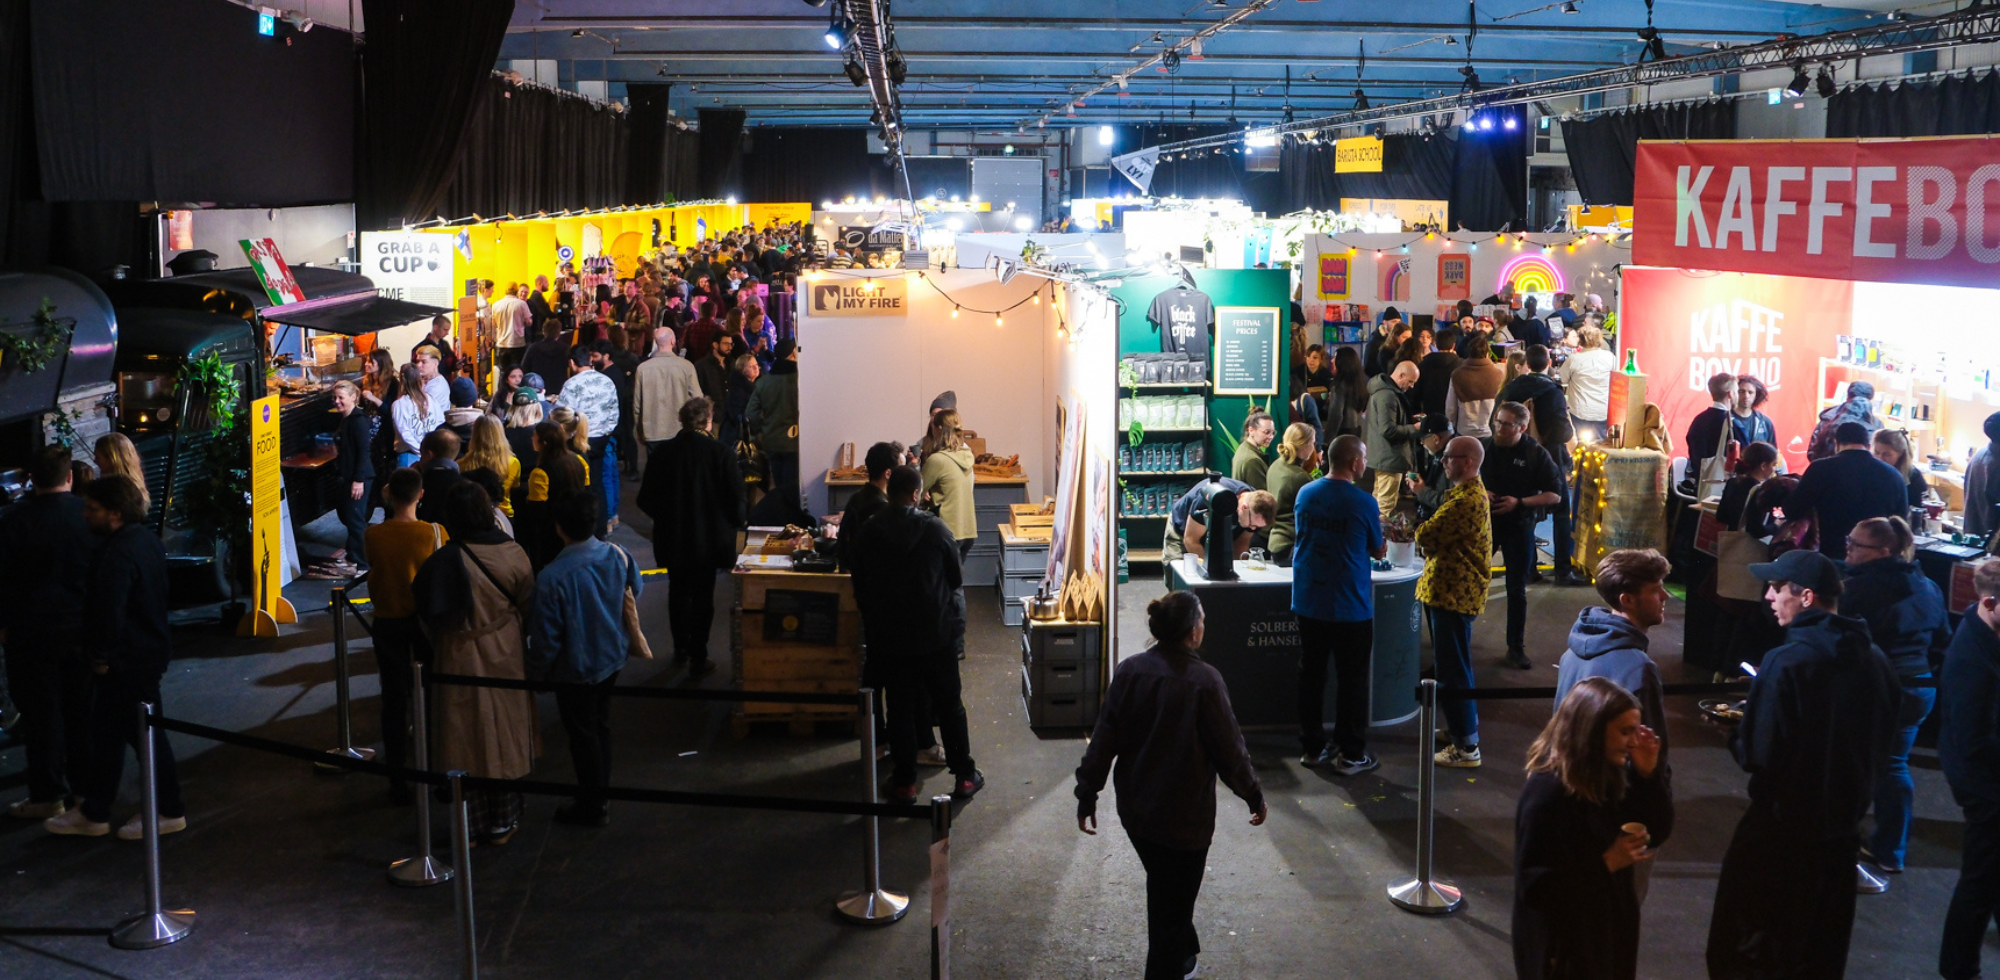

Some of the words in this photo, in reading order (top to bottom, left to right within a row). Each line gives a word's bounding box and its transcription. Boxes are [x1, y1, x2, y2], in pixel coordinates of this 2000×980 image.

[1337, 148, 1358, 163] BARISTA
[1359, 146, 1382, 162] SCHOOL
[1126, 164, 1144, 180] LY!
[377, 241, 423, 255] GRAB
[428, 241, 440, 254] A
[379, 256, 423, 273] CUP
[842, 286, 886, 298] LIGHT
[843, 298, 866, 309] MY
[869, 298, 901, 308] FIRE
[1232, 319, 1261, 327] FESTIVAL
[1689, 298, 1784, 354] KAFFE
[1235, 327, 1258, 335] PRICES
[257, 437, 275, 455] FOOD
[1247, 637, 1256, 647] &
[1258, 635, 1302, 647] HANSE
